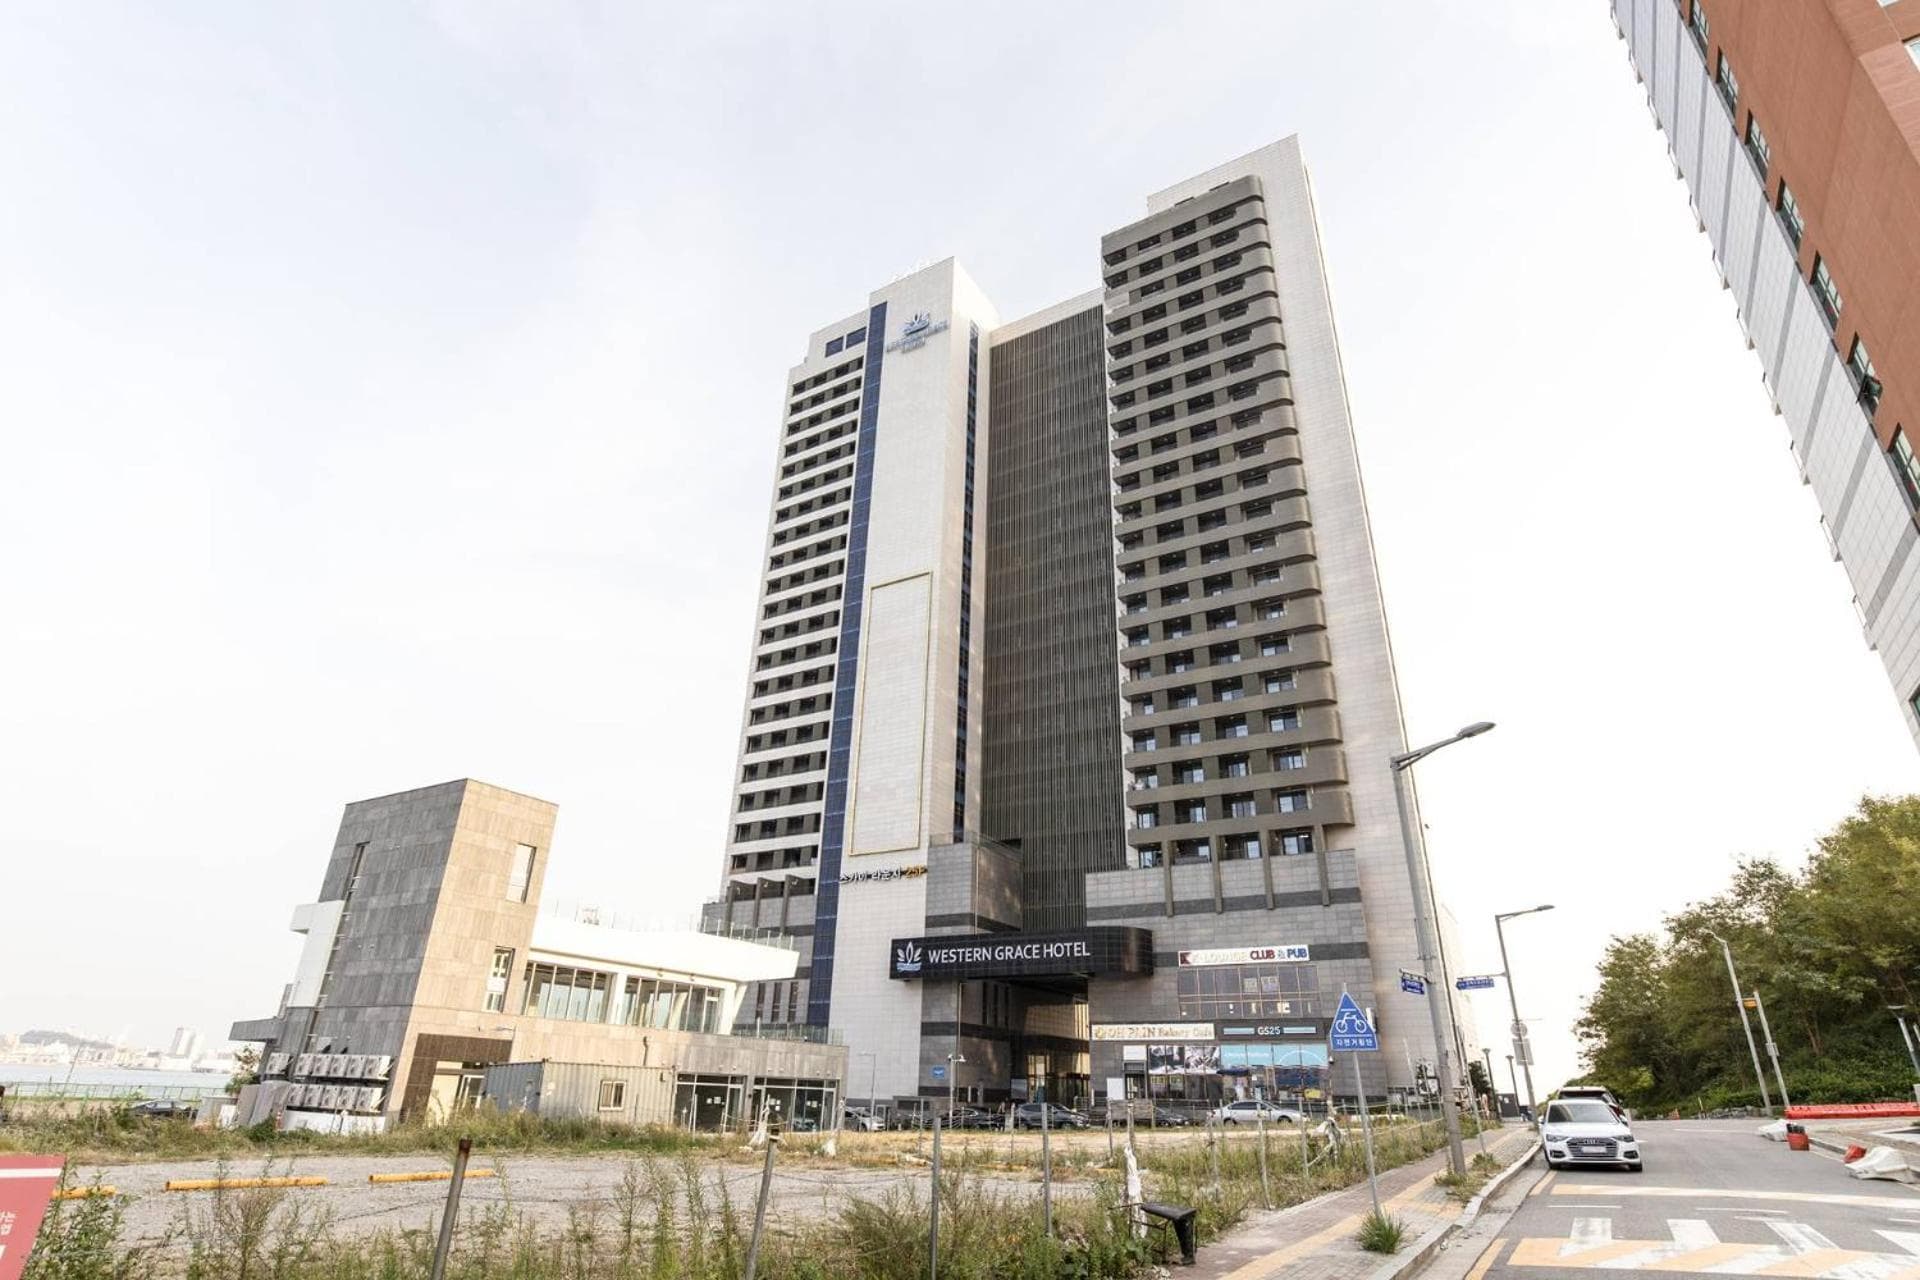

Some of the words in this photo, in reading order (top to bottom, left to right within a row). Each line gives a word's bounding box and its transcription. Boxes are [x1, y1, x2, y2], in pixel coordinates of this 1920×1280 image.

[928, 947, 992, 964] WESTERN
[994, 944, 1041, 961] GRACE
[1043, 941, 1091, 958] HOTEL
[1249, 949, 1276, 960] CLUB
[1287, 947, 1308, 958] PUB
[1257, 1025, 1281, 1036] GS25
